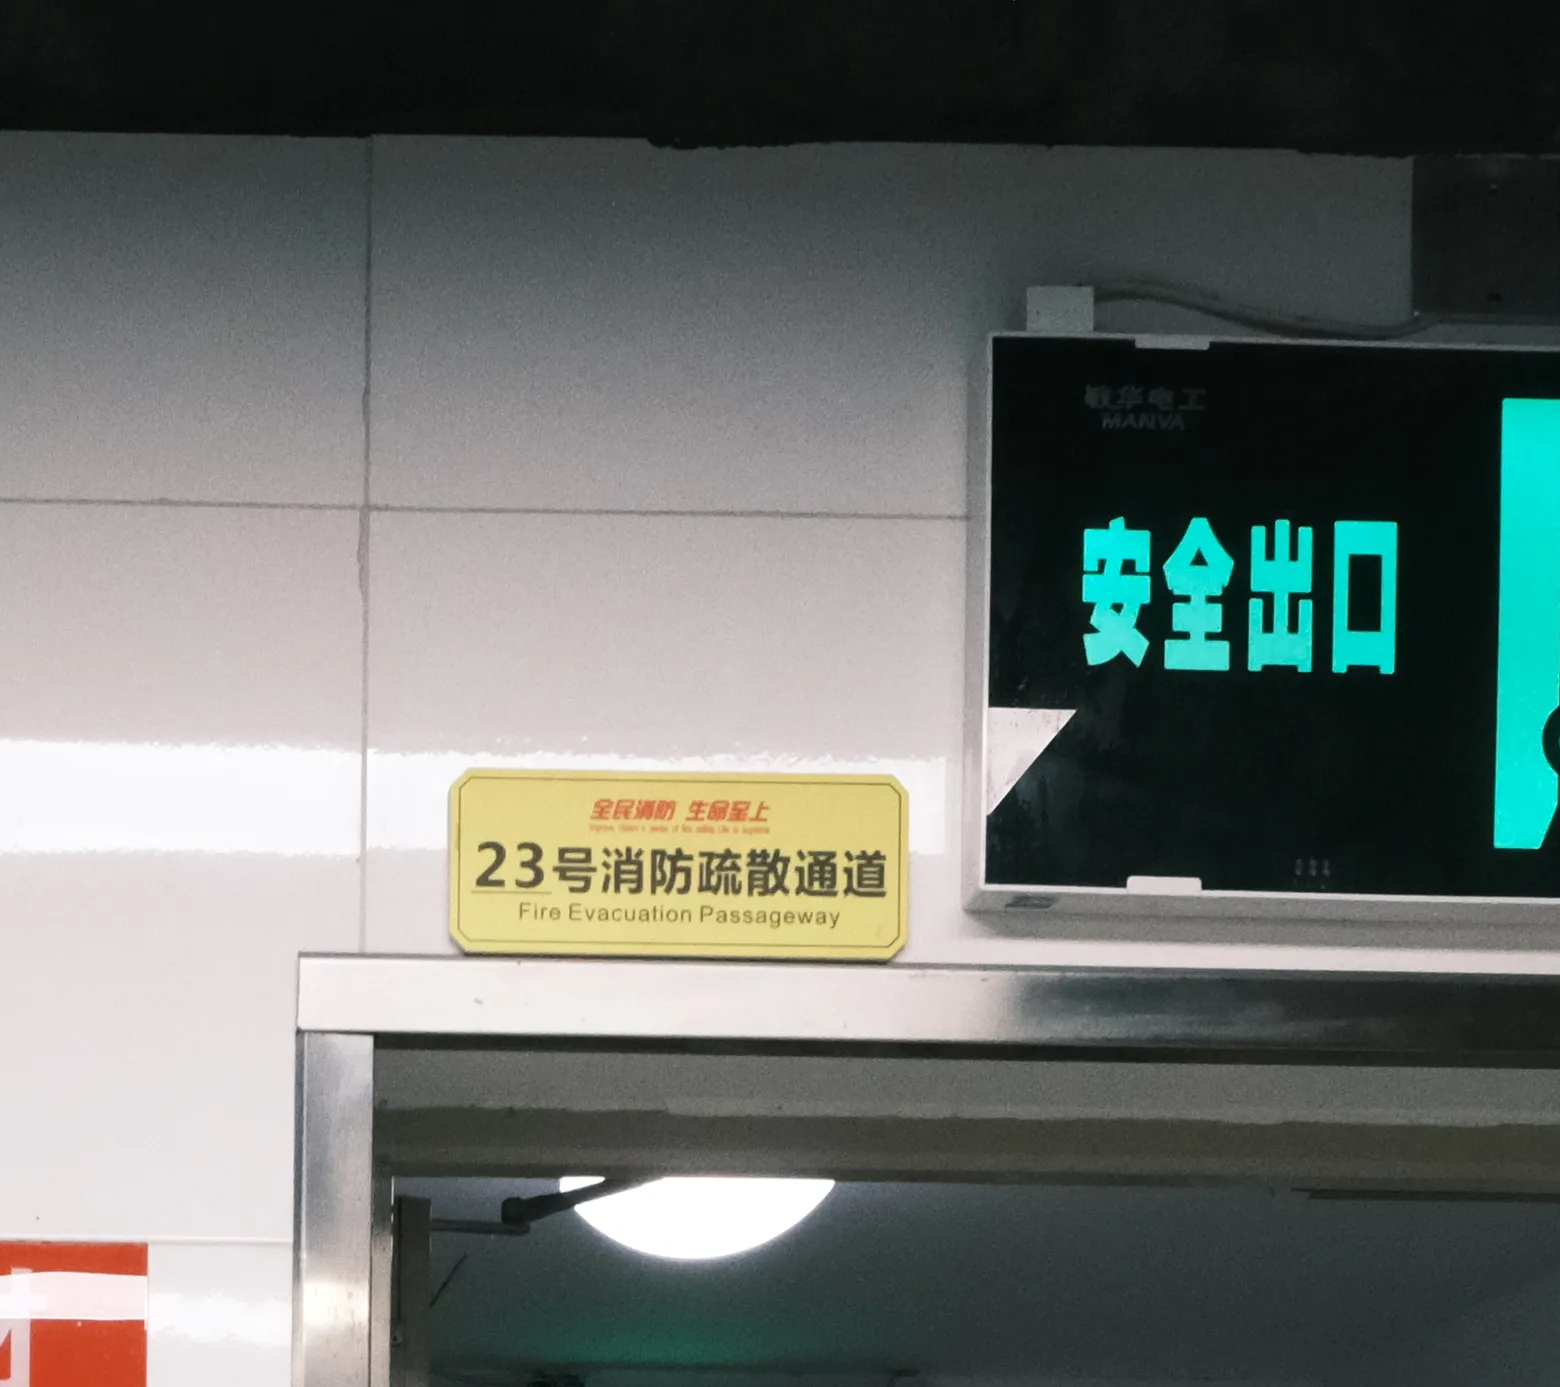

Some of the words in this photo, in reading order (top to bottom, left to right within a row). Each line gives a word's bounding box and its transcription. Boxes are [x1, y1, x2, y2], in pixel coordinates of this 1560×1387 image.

[1082, 516, 1398, 675] 安全出口
[589, 798, 679, 821] 全民消防
[684, 800, 770, 823] 生命至上
[475, 841, 887, 898] 23号消防疏散通道
[519, 902, 562, 921] Fire
[568, 903, 692, 924] Evacuation
[699, 905, 840, 929] Passageway
